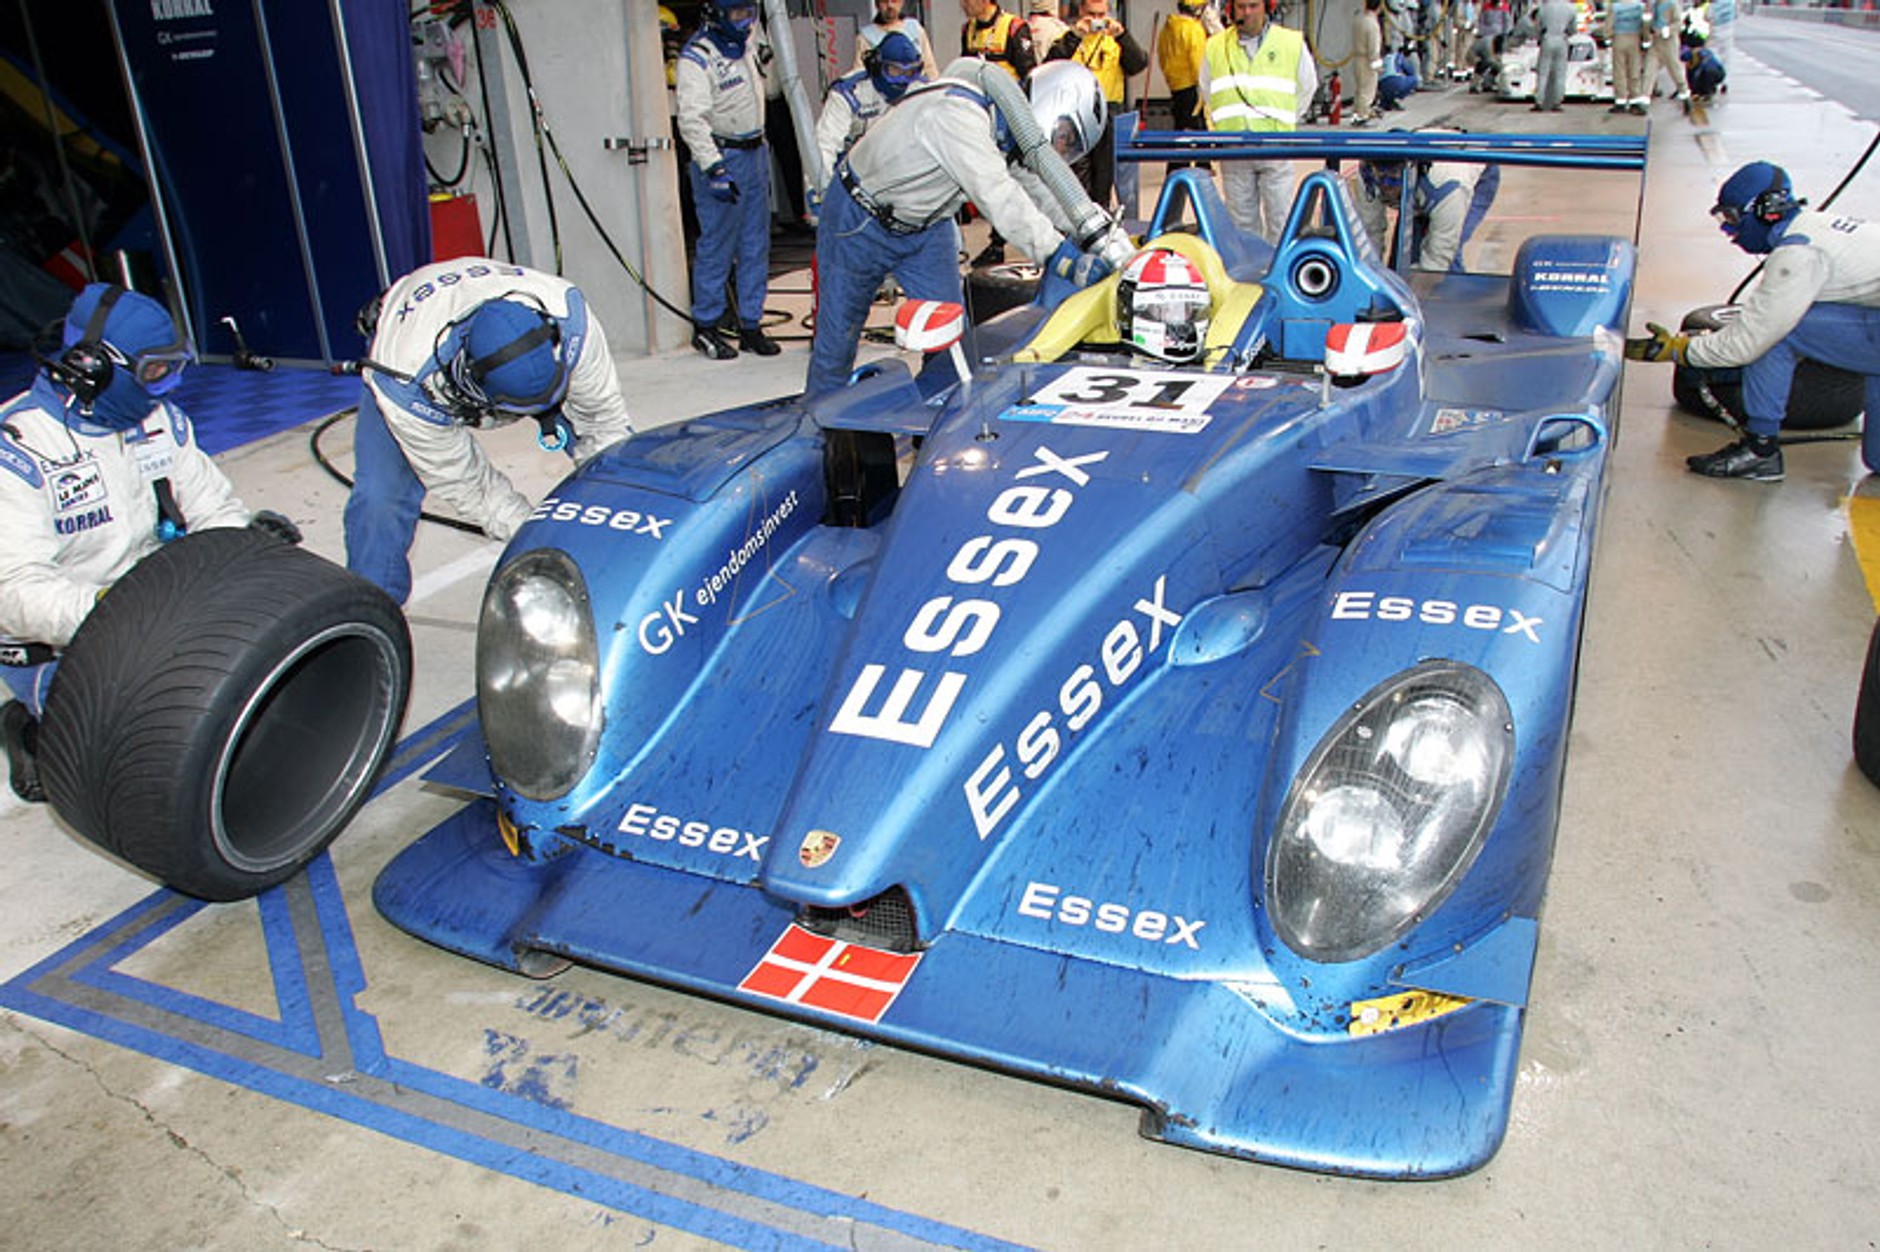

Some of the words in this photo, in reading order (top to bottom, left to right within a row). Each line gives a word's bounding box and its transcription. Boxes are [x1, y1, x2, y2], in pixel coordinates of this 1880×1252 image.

[1534, 272, 1609, 283] KORRAL
[1058, 375, 1197, 410] 31
[54, 505, 114, 535] KORRAL
[527, 498, 673, 540] Essex
[638, 589, 699, 656] GK
[695, 489, 799, 606] ejendomsinvest
[828, 446, 1110, 748] Essex
[1331, 591, 1543, 644] Essex
[963, 574, 1184, 841] Essex
[618, 803, 770, 862] Essex
[1018, 881, 1207, 950] Essex
